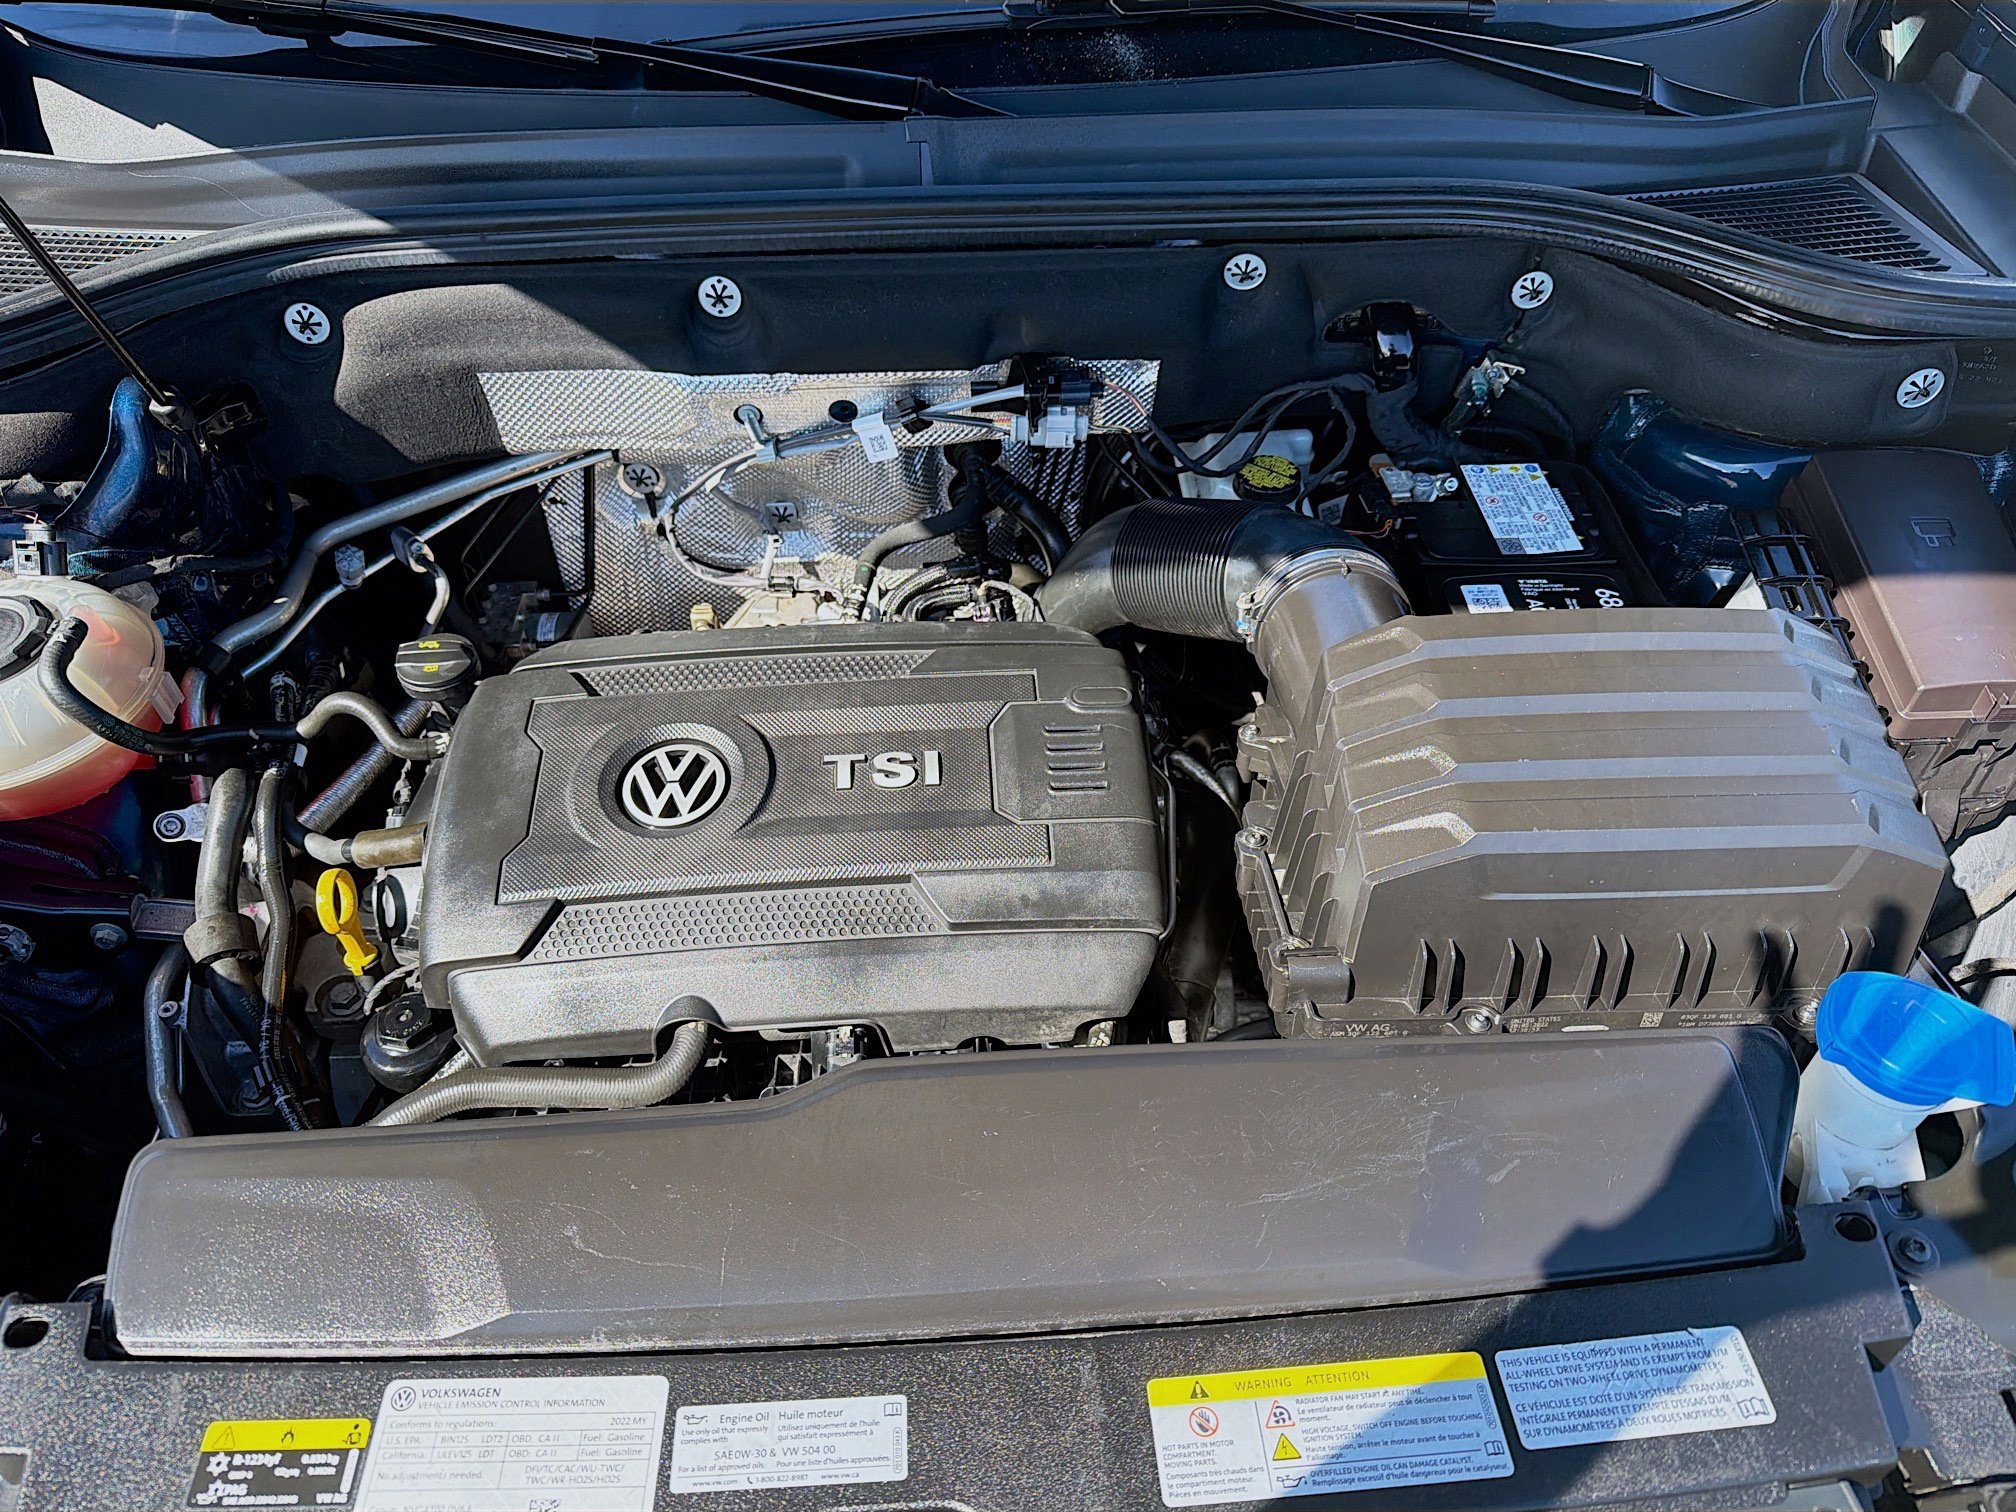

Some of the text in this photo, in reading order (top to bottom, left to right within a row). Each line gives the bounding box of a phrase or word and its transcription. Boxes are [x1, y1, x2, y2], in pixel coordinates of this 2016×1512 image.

[822, 750, 943, 791] TSI
[622, 743, 726, 828] VW
[1346, 1024, 1390, 1032] VW AG
[1501, 1337, 1704, 1368] THIS VEHICLE IS EQUIPPED WITH A PERMANENT
[1505, 1347, 1727, 1379] ALL-WHEEL DRIVE SYSTEM AND IS EXEMPT FROM I/M
[1234, 1370, 1369, 1391] WARNING ATTENTION
[1508, 1368, 1648, 1392] TESTING ON TWO-WHEEL DRIVE
[421, 1387, 501, 1398] VOLKSWAGEN
[1295, 1396, 1328, 1404] RADIATOR
[1360, 1391, 1379, 1399] START
[1515, 1403, 1526, 1412] CE
[1528, 1396, 1571, 1411] VÉHICULE
[1573, 1396, 1586, 1406] EST
[1614, 1391, 1636, 1402] D'UN
[1676, 1385, 1688, 1394] DE
[1689, 1378, 1754, 1393] TRANSMISSION
[418, 1399, 605, 1409] VEHICLE EMISSION CONTROL INFORMATION
[1307, 1404, 1343, 1414] ventilateur
[1355, 1401, 1385, 1409] radiateur
[1388, 1400, 1404, 1408] peut
[1414, 1395, 1450, 1404] déclencher
[1519, 1396, 1707, 1425] INTÉGRALE PERMANENT ET D'ESSAIS
[720, 1411, 769, 1425] Engine Oil
[778, 1408, 843, 1420] Huile moteur
[1299, 1415, 1330, 1423] moment.
[389, 1420, 431, 1429] Conforms
[434, 1420, 442, 1428] to
[610, 1417, 630, 1425] 2022
[632, 1417, 646, 1425] MY
[778, 1423, 803, 1431] Utilisez
[805, 1422, 847, 1430] uniquement
[1301, 1412, 1482, 1435] HIGH VOLTAGE, SWITCH OFF ENGINE BEFORE TOUCHING
[1523, 1427, 1540, 1438] SUR
[1626, 1416, 1649, 1427] DEUX
[1652, 1412, 1681, 1424] ROUES
[695, 1428, 709, 1436] only
[736, 1425, 768, 1434] expressly
[819, 1429, 867, 1439] expressément
[481, 1434, 503, 1443] LDT2
[680, 1437, 710, 1445] complies
[1303, 1432, 1363, 1443] IGNITION SYSTEM.
[1306, 1445, 1326, 1453] Haute
[1327, 1443, 1356, 1452] tension,
[1357, 1440, 1380, 1448] arrêter
[1390, 1437, 1414, 1445] moteur
[1447, 1432, 1473, 1440] toucher
[1177, 1442, 1198, 1450] PARTS
[1209, 1439, 1234, 1447] MOTOR
[478, 1449, 495, 1458] LDT
[714, 1445, 835, 1460] SAE 0W-30 & VW 504 00
[1163, 1449, 1216, 1460] COMPARTMENT.
[718, 1463, 750, 1471] approved
[1164, 1458, 1216, 1469] MOVING PARTS.
[1310, 1456, 1473, 1477] OVERFILLED ENGINE OIL CAN DAMAGE CATALYST.
[391, 1471, 446, 1482] adjustments
[821, 1471, 859, 1479] www.vw.ca
[1165, 1469, 1207, 1480] Composants
[1223, 1466, 1246, 1474] chauds
[1248, 1464, 1264, 1472] dans
[1312, 1475, 1356, 1487] Remplissage
[1358, 1473, 1384, 1482] excessif
[1386, 1471, 1409, 1479] d'huile
[1410, 1468, 1446, 1479] dangereux
[1448, 1467, 1463, 1475] pour
[1175, 1477, 1225, 1489] compartiment
[1227, 1475, 1254, 1484] moteur.
[1168, 1490, 1191, 1498] Pièces
[1203, 1485, 1247, 1495] mouvement.
